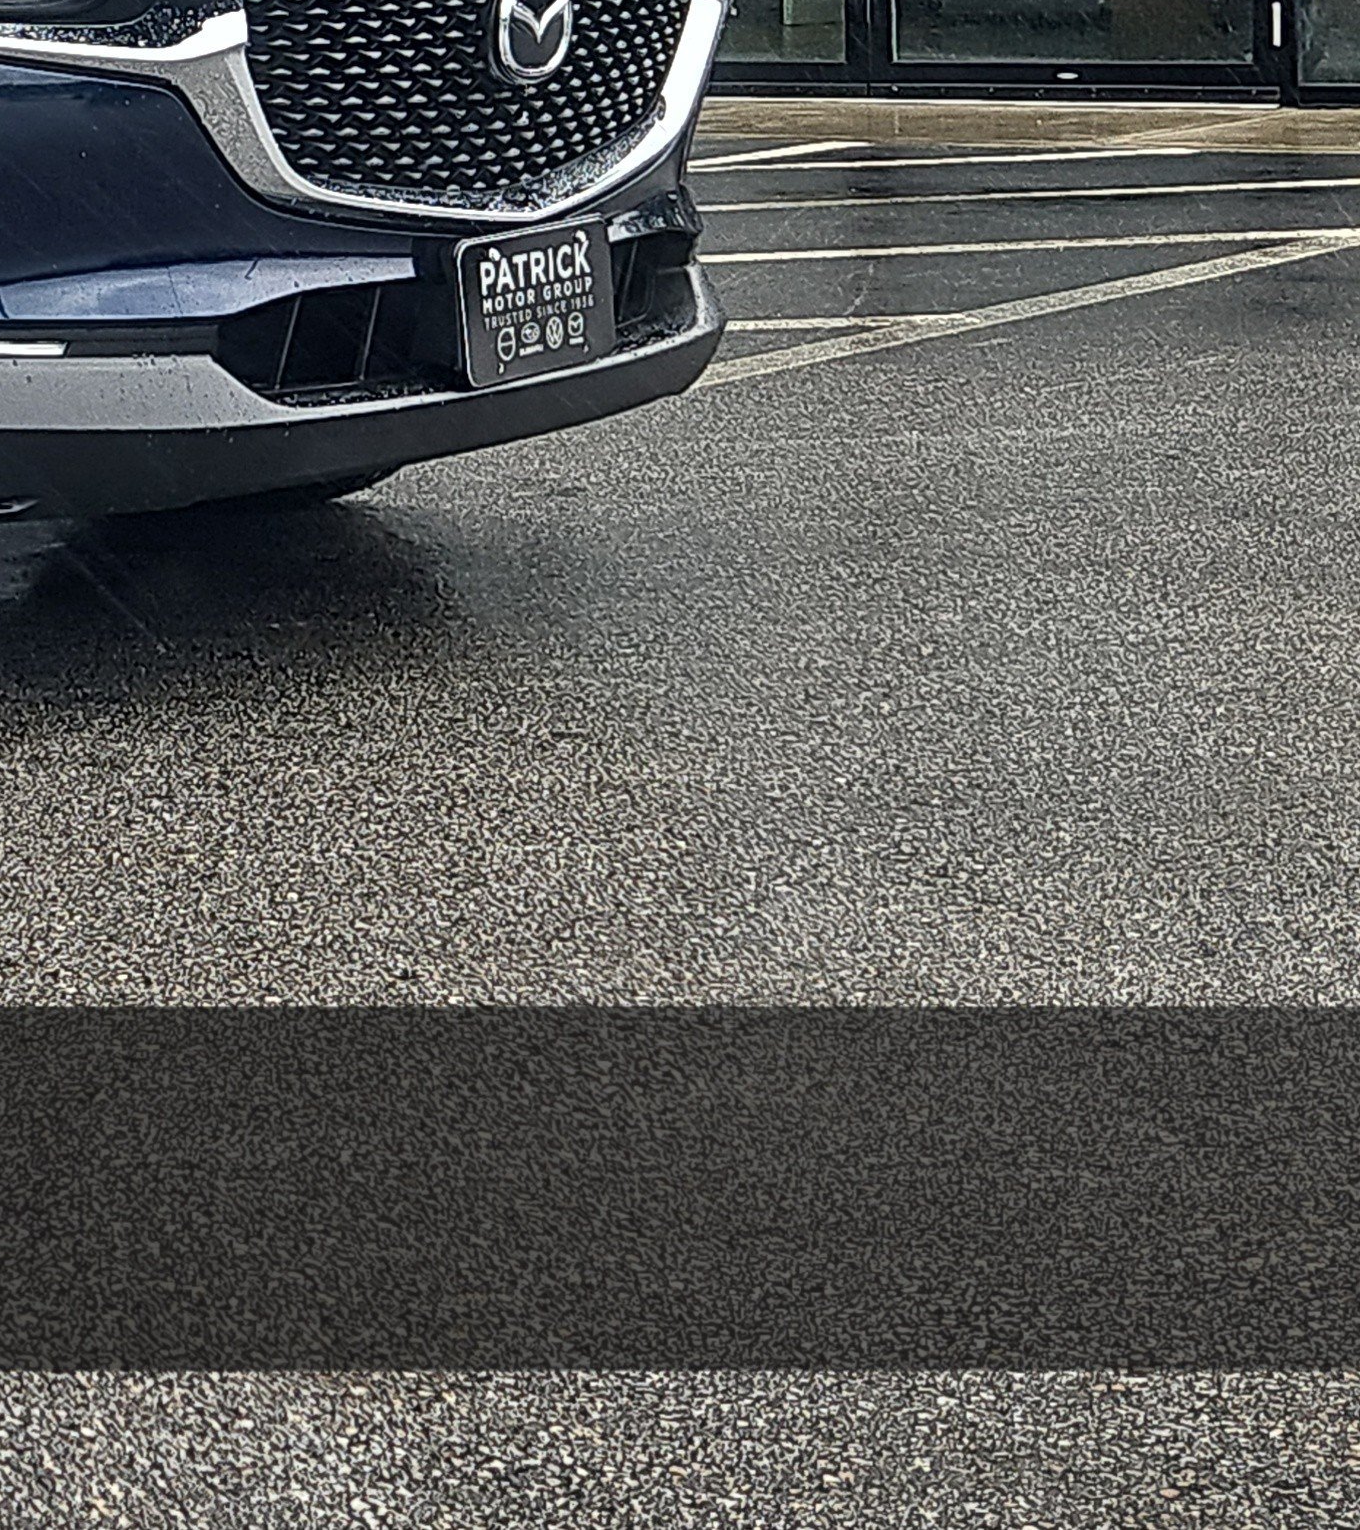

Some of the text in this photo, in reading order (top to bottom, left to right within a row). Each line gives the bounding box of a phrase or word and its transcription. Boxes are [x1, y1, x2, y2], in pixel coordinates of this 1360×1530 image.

[480, 240, 591, 296] PATRICK
[482, 277, 593, 314] MOTOR GROUP
[484, 308, 532, 331] TRUSTED
[536, 299, 568, 319] SINCE
